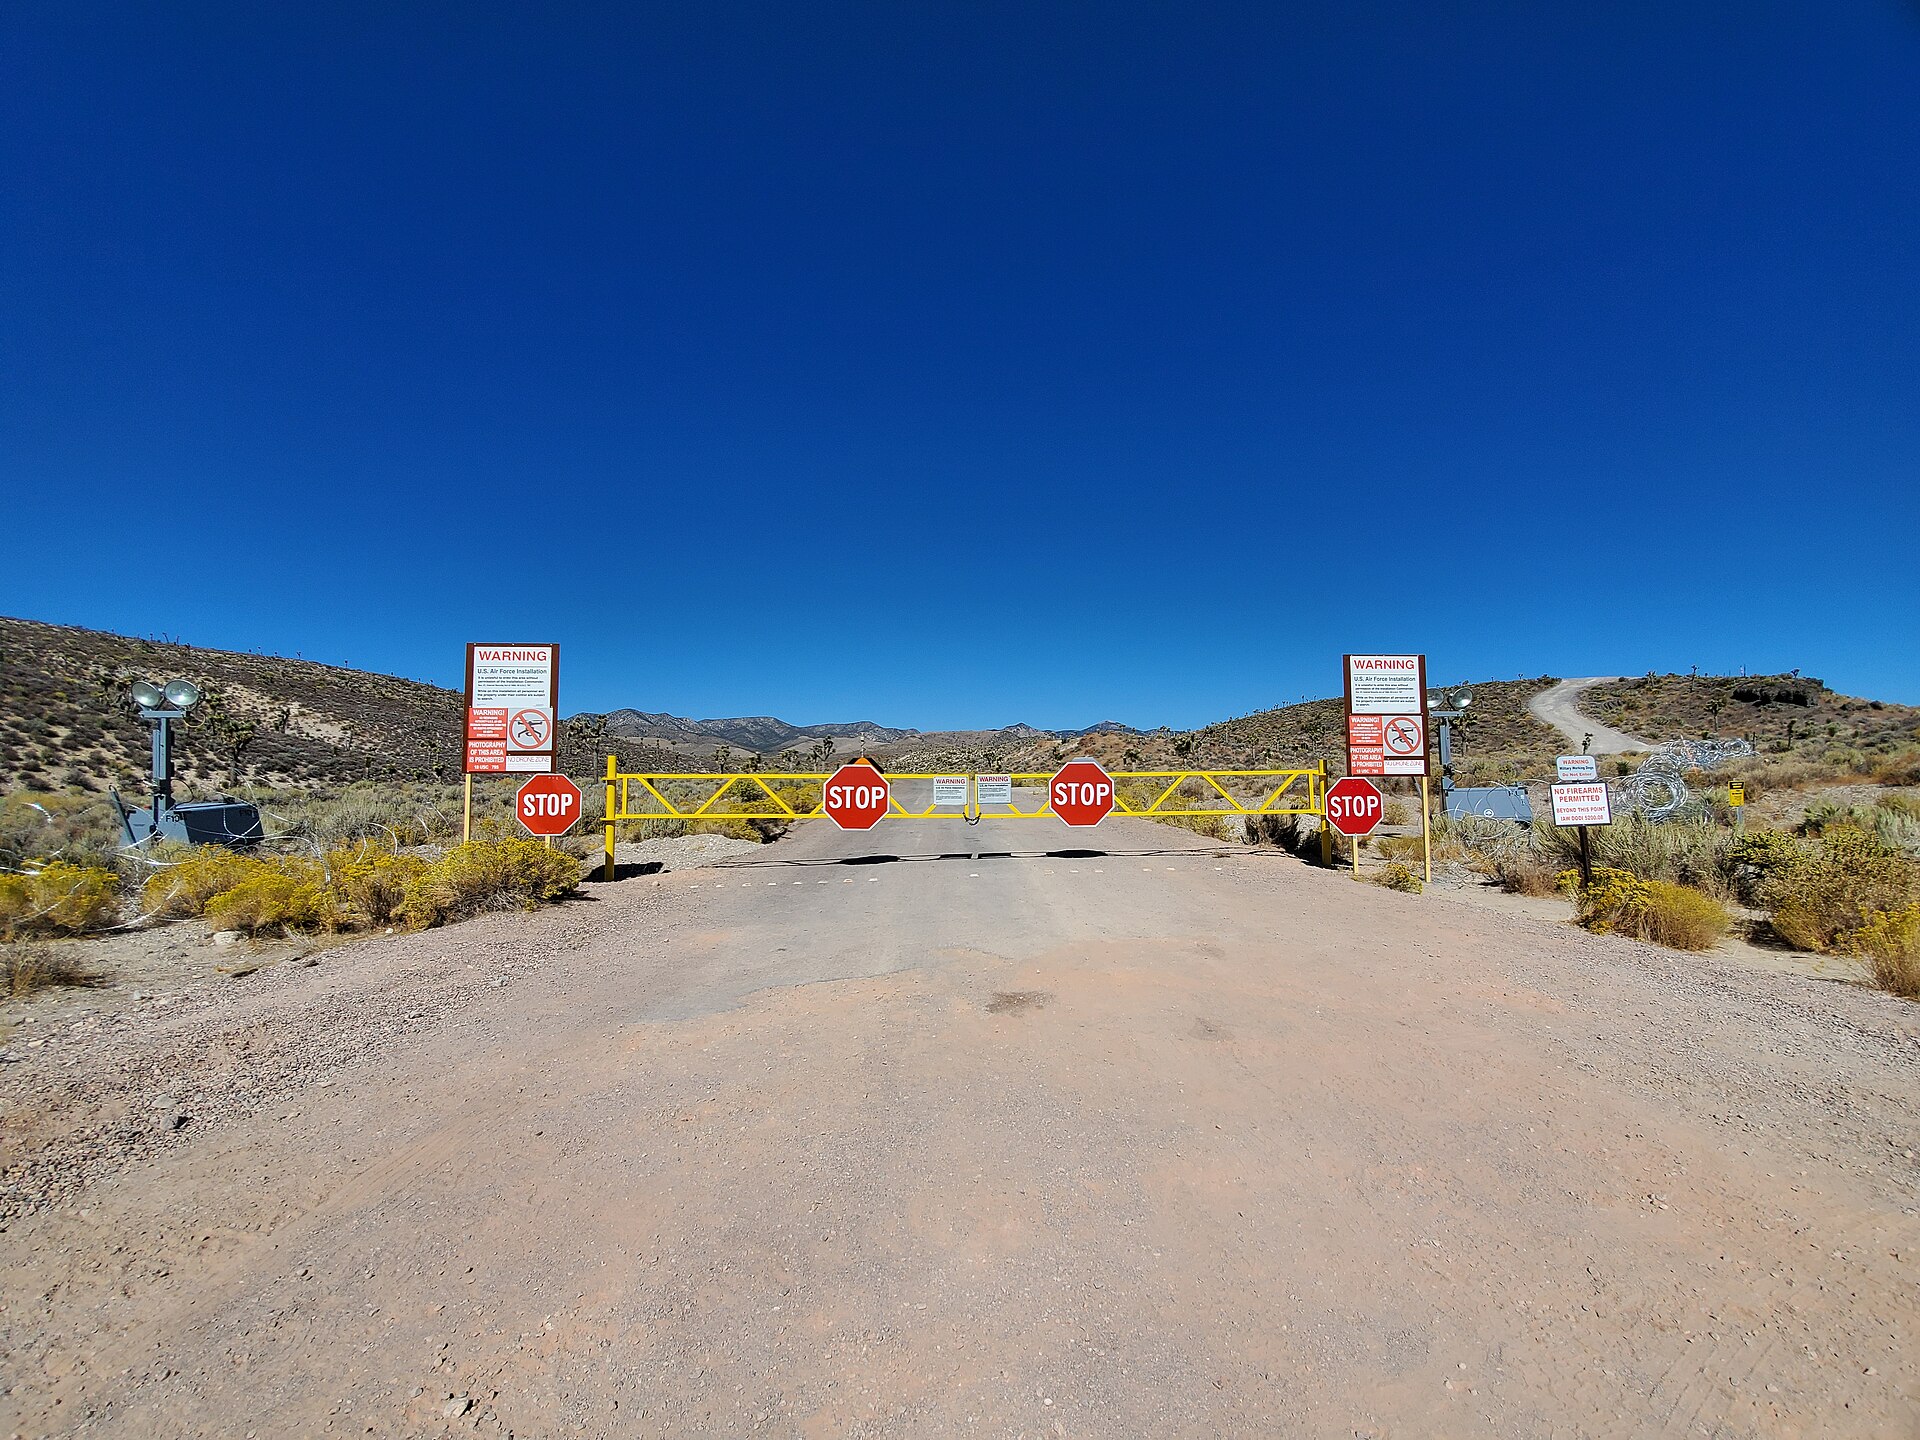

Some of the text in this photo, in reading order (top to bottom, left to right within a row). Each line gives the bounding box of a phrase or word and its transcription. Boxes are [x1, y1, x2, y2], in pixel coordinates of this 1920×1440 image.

[478, 650, 547, 661] WARNING
[1354, 660, 1414, 669] WARNING
[829, 786, 885, 808] STOP
[1054, 782, 1110, 806] STOP
[523, 794, 573, 816] STOP
[1330, 796, 1378, 817] STOP
